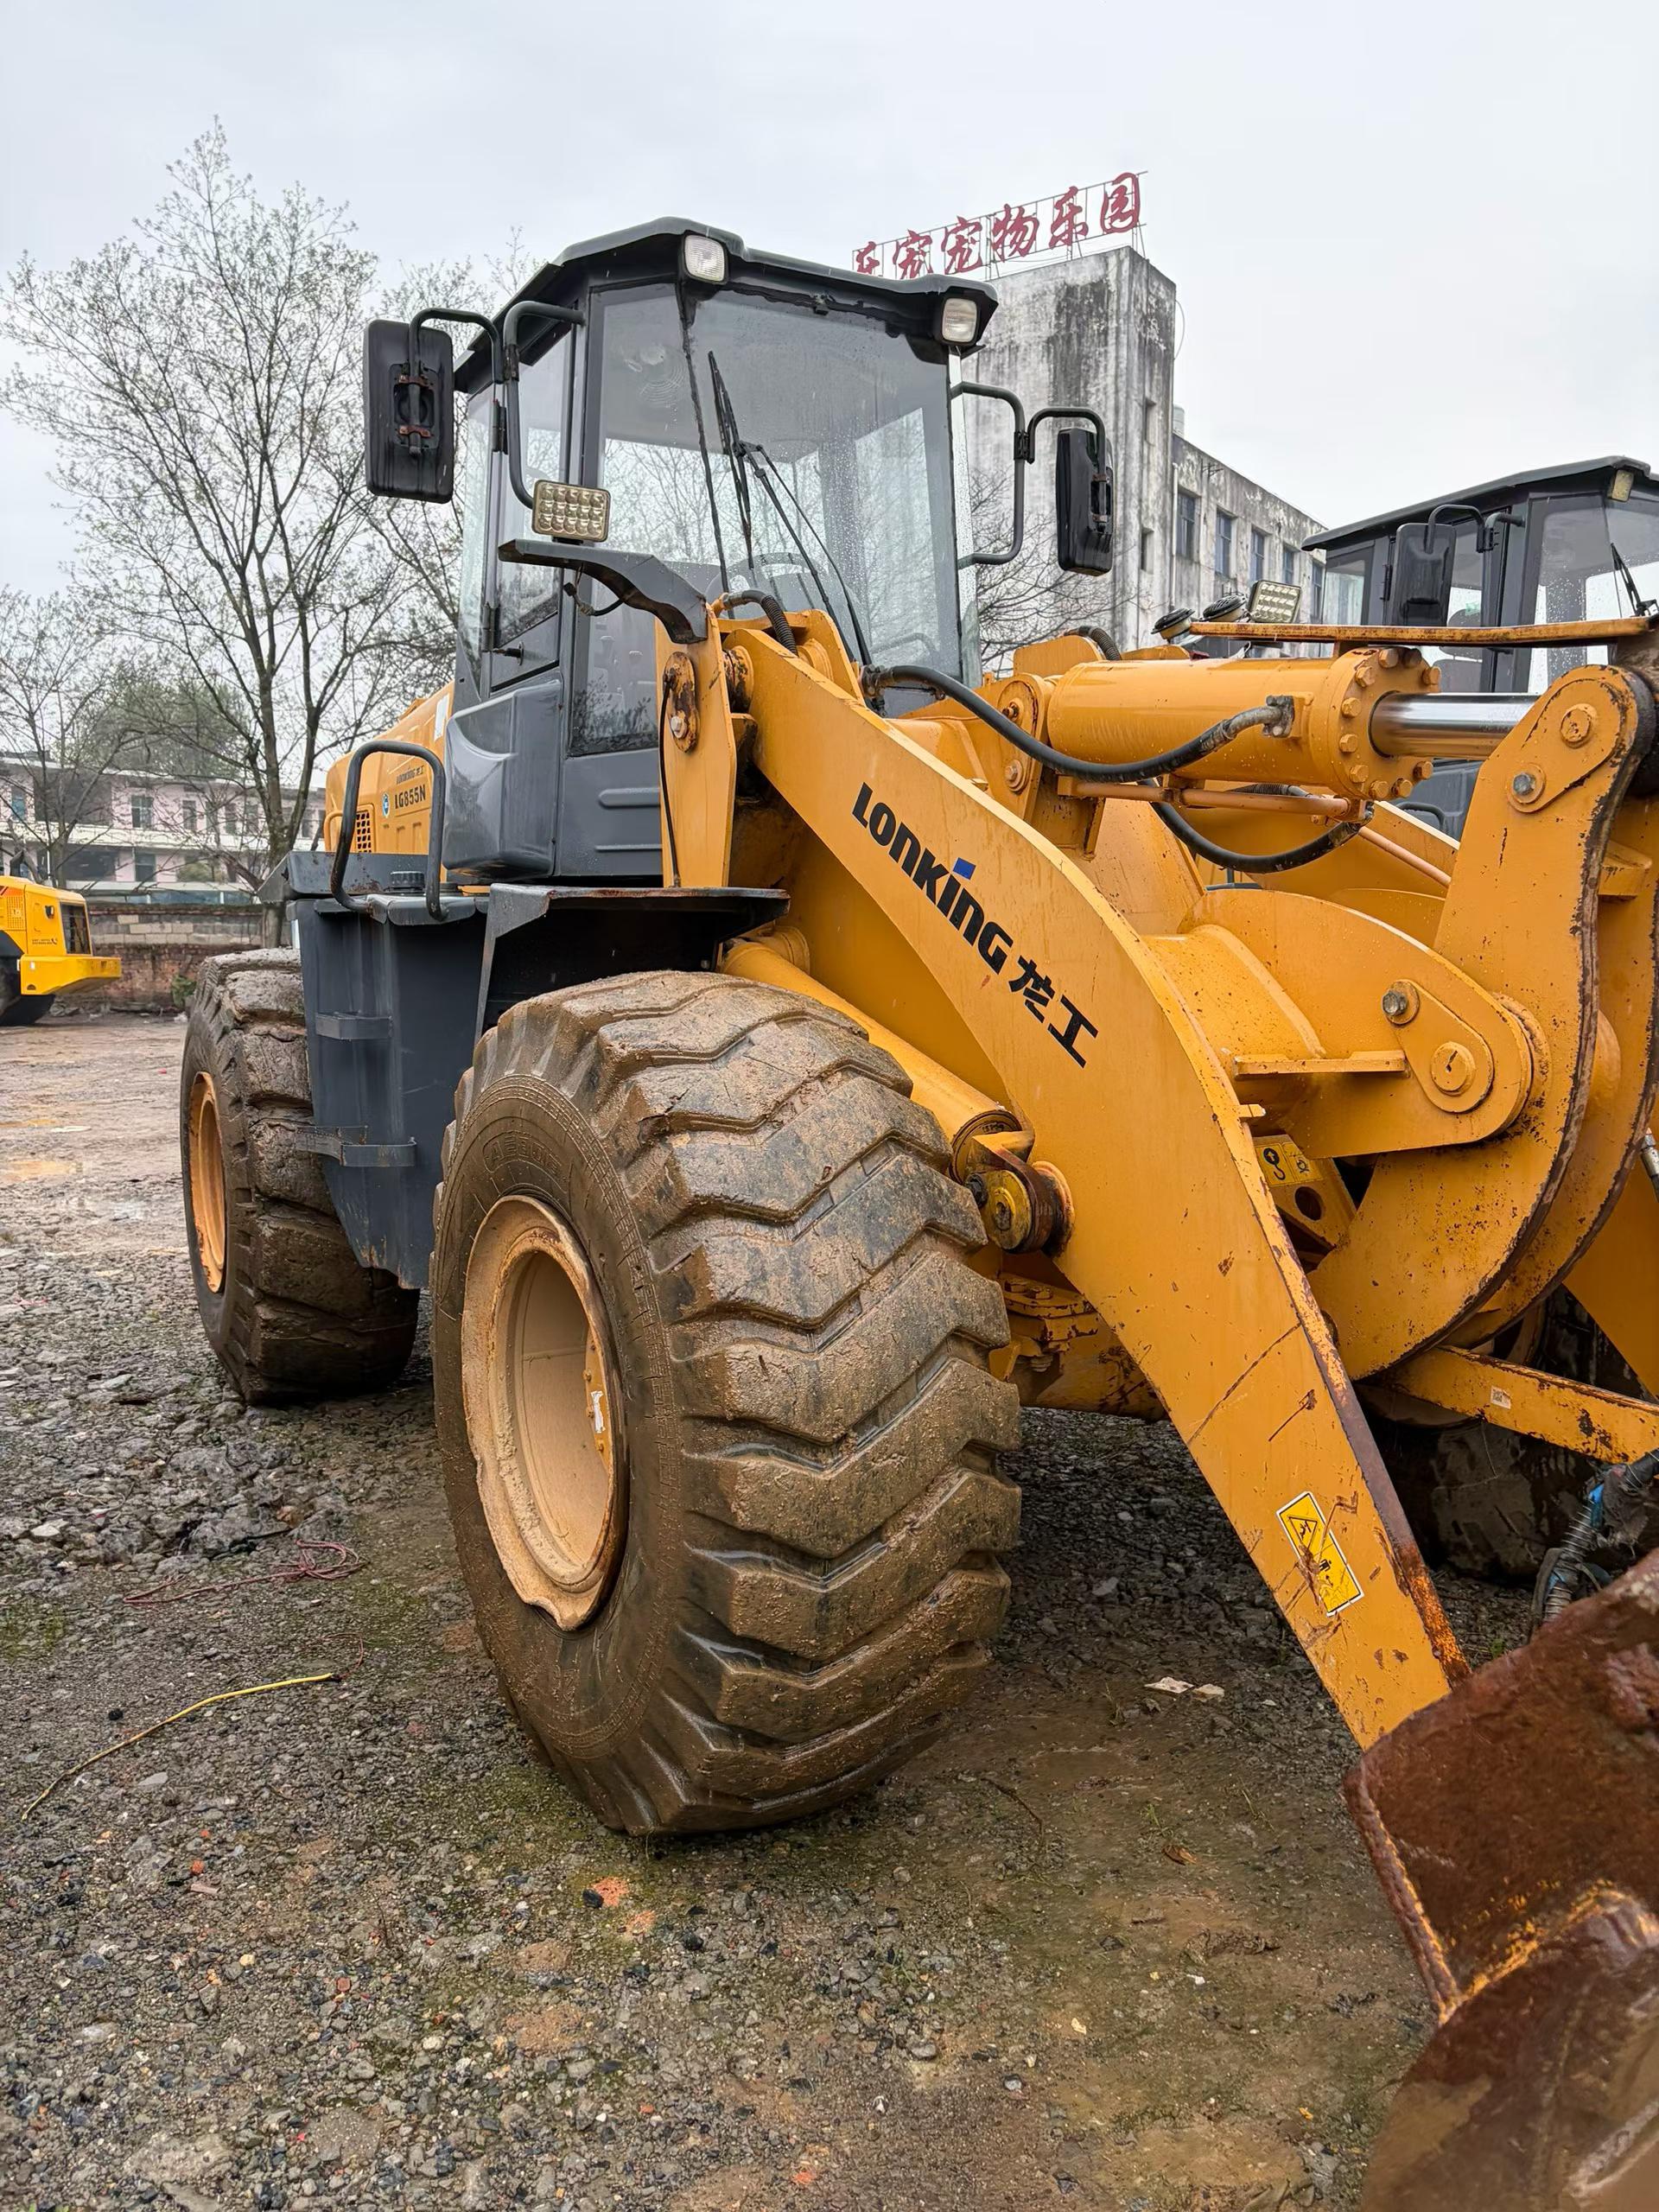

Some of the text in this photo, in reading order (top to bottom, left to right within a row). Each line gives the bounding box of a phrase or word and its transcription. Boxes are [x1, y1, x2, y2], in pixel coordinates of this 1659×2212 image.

[394, 784, 426, 809] LG855N
[852, 782, 1098, 1068] LONKING 龙工
